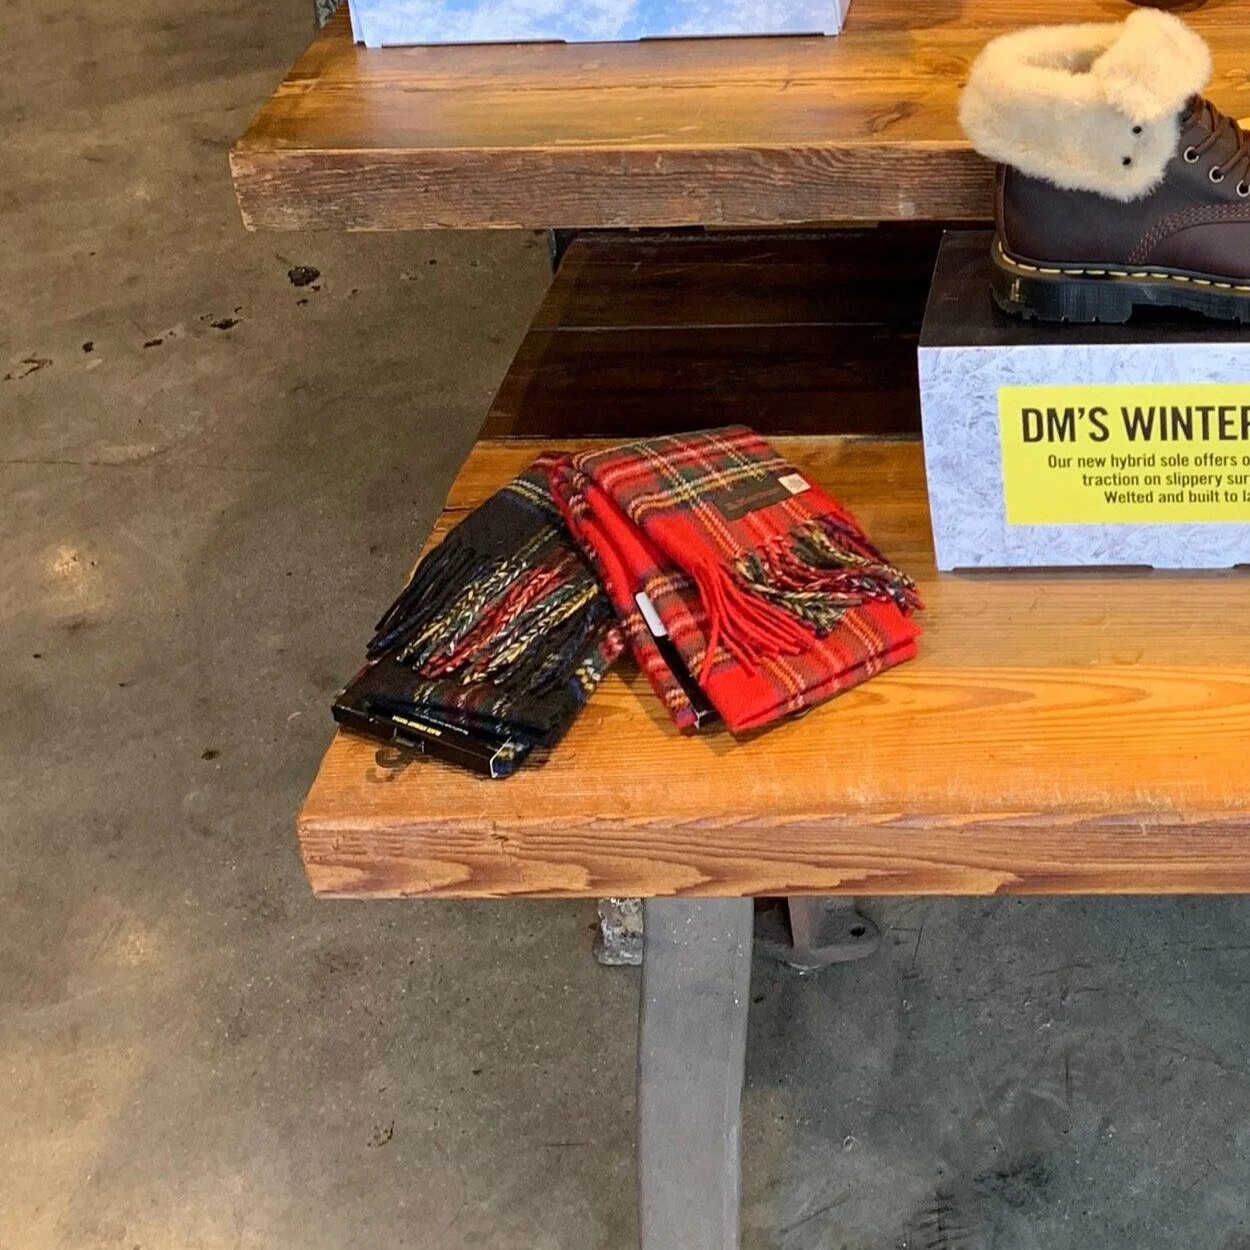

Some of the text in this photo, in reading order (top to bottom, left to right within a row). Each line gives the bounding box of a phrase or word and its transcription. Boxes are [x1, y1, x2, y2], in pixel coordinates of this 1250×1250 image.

[1021, 406, 1111, 444] DM'S
[1047, 454, 1073, 469] Our
[1077, 457, 1107, 469] new
[1110, 453, 1156, 471] hybrid
[1160, 453, 1190, 468] sole
[1193, 452, 1238, 467] offers
[1082, 472, 1140, 487] traction
[1143, 475, 1162, 486] on
[1165, 471, 1223, 489] slippery
[1104, 490, 1154, 504] Welted
[1157, 490, 1185, 504] and
[1188, 489, 1220, 504] built
[1223, 490, 1239, 503] to
